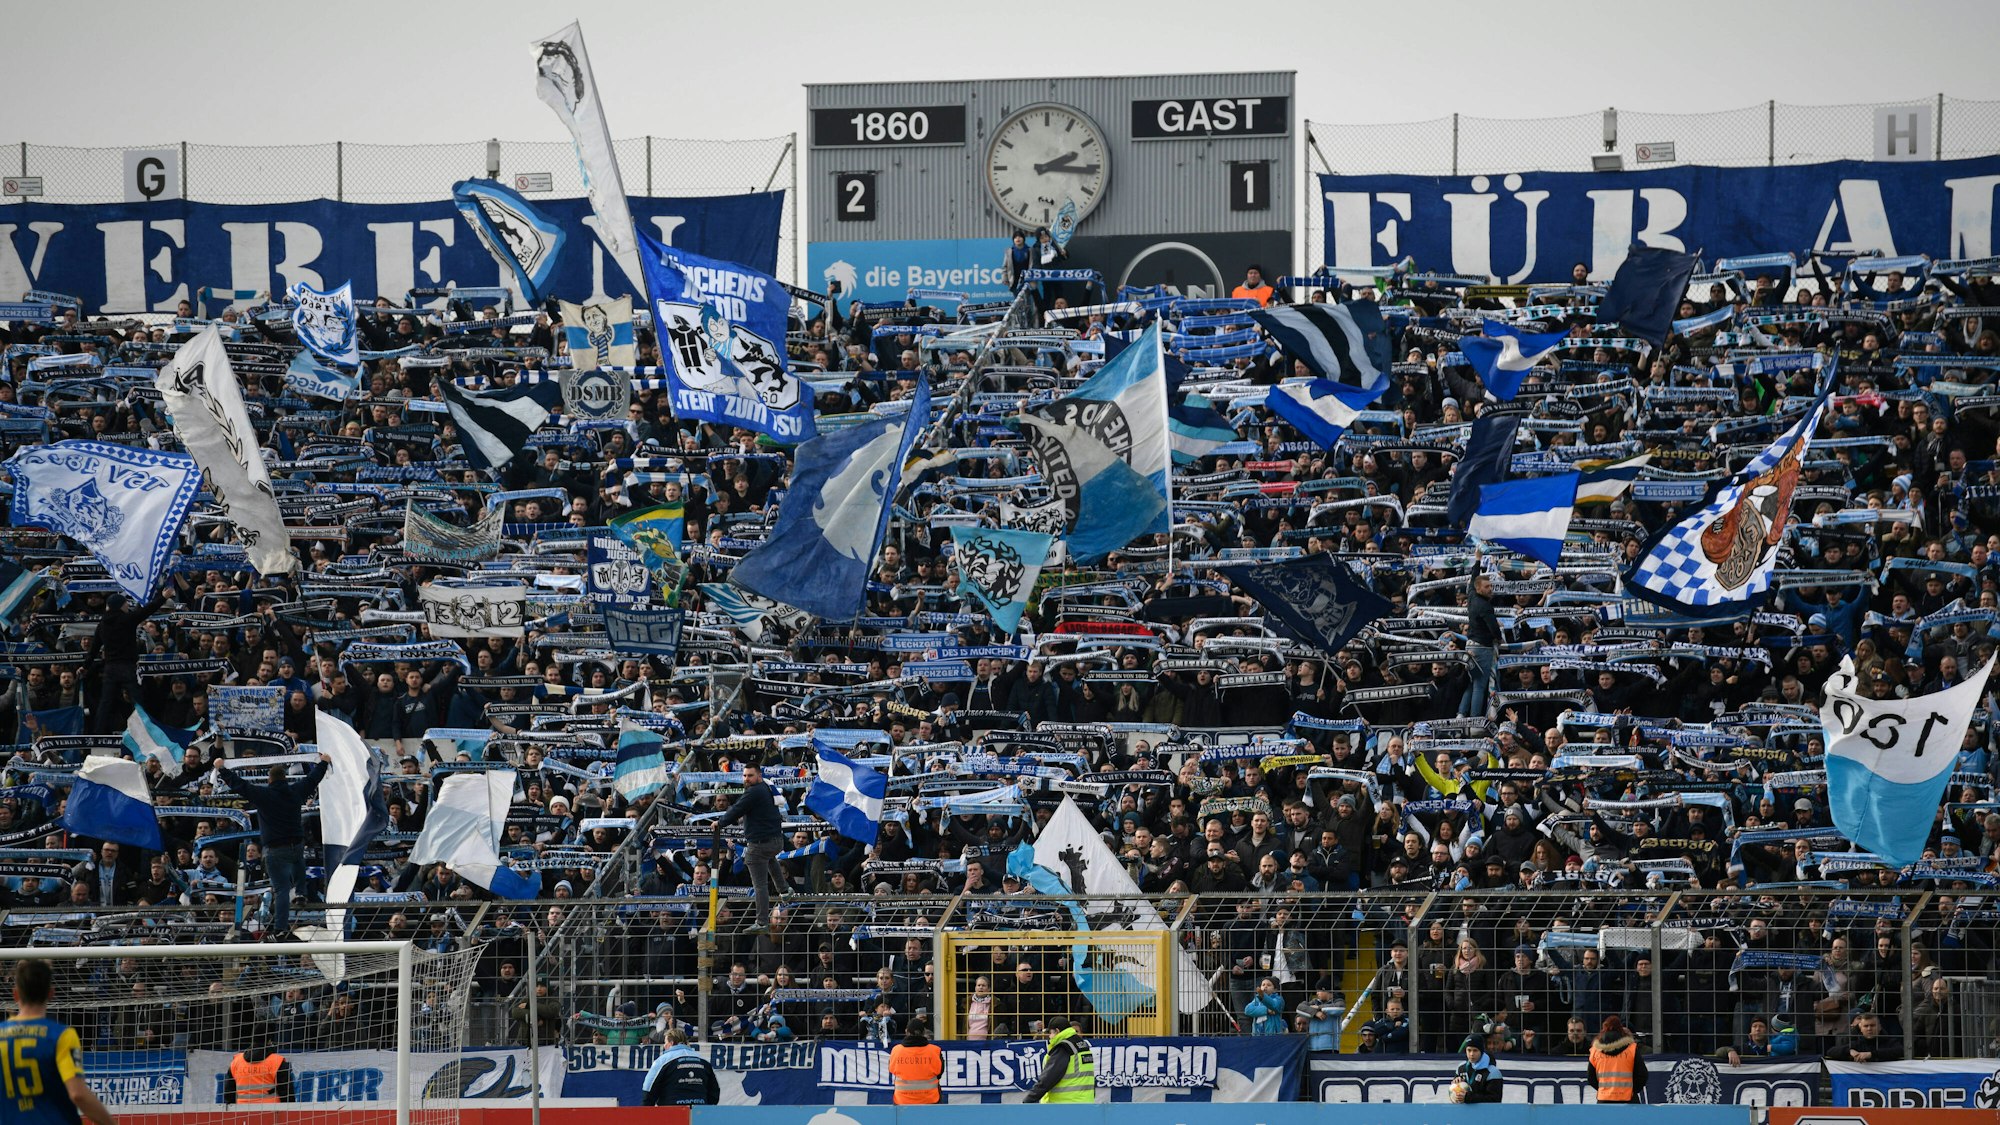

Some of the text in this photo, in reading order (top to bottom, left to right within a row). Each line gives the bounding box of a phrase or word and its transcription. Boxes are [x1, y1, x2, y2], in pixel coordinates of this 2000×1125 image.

[1157, 98, 1261, 134] GAST
[850, 111, 929, 141] 1860
[1886, 112, 1918, 156] H
[136, 157, 166, 197] G
[1242, 170, 1255, 204] 1
[846, 180, 867, 213] 2
[1325, 174, 1687, 284] FÜR
[0, 216, 688, 318] VEREN
[865, 264, 1005, 289] die Bayerisc
[1057, 268, 1092, 280] 1860
[794, 287, 810, 298] FÜR
[0, 310, 40, 318] ECHZGER
[1021, 340, 1064, 351] MÜNCHEN
[571, 386, 622, 402] DSMB
[724, 395, 769, 426] ZUM
[1284, 441, 1310, 453] 1860
[1255, 497, 1292, 508] MÜNCHEN
[422, 601, 523, 628] 13 12
[859, 618, 904, 627] ÜNCHEN
[1631, 629, 1656, 638] ZUM
[942, 646, 1016, 658] DES IS MÜNCHEN
[1396, 653, 1453, 662] COMITIVA
[149, 662, 185, 671] MÜNCHEN
[188, 662, 203, 670] VON
[912, 669, 960, 678] SECHZGER
[1221, 674, 1275, 686] COMITIVA
[758, 684, 788, 692] VEREIN
[1354, 687, 1410, 699] COMITIVA
[1579, 714, 1597, 723] TSV
[255, 729, 269, 738] FÜR
[53, 738, 112, 747] VEREIN FÜR
[1219, 747, 1242, 759] 1860
[1244, 743, 1294, 756] MÜNCHEN
[1561, 745, 1593, 754] NCHEN
[1087, 773, 1164, 782] MÜNCHEN VON 1860
[1406, 798, 1471, 812] MÜNCHEN 1860
[2, 832, 24, 844] EREIN
[16, 866, 34, 874] VON
[518, 859, 598, 870] TSV 1860 MÜNCHEN
[687, 886, 749, 894] TSV MÜNCHEN
[1663, 920, 1692, 929] NCHEN
[568, 1046, 619, 1071] 50+1
[710, 1042, 815, 1071] BLEIBEN!
[896, 1056, 933, 1066] SECURITY
[0, 1037, 44, 1099] 15
[820, 1041, 1014, 1087] MÜNENS
[99, 1089, 181, 1105] ONVERBOT
